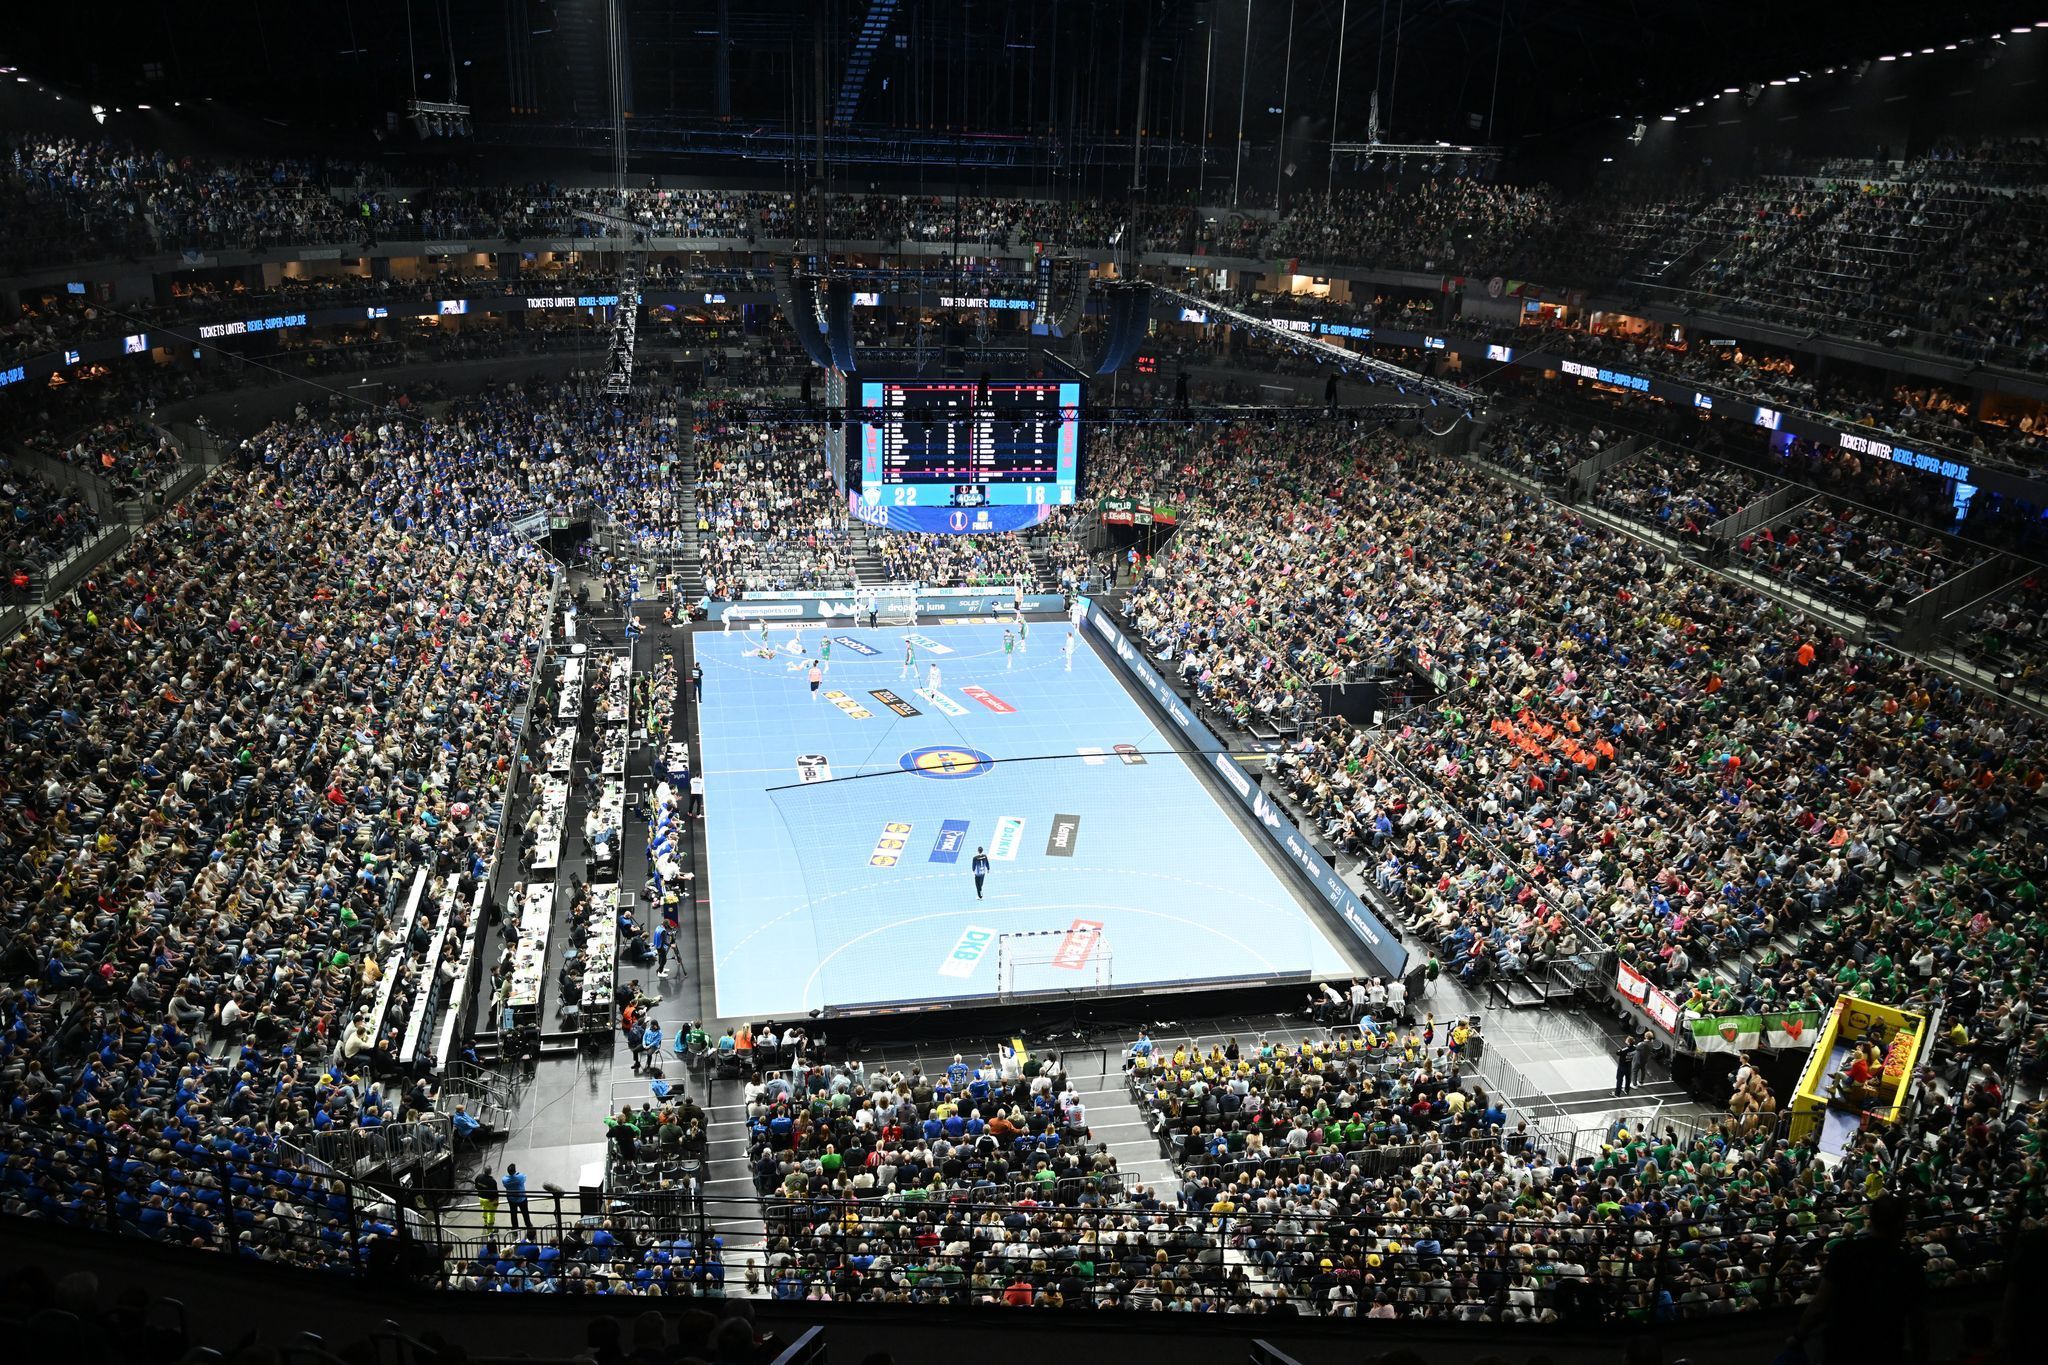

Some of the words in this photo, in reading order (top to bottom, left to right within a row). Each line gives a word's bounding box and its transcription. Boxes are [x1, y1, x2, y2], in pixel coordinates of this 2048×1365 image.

[527, 297, 554, 309] TICKETS
[199, 324, 225, 339] TICKETS
[225, 321, 247, 335] UNTER:
[247, 314, 306, 332] REXEL-SUPER-CUP.DE
[1561, 360, 1581, 375] TICKETS
[1581, 365, 1598, 379] UNTER:
[1840, 433, 1868, 453] TICKETS
[1867, 440, 1892, 460] UNTER:
[1892, 447, 1969, 482] REXEL-SUPER-CUP.DE
[894, 486, 917, 506] 22
[1026, 485, 1045, 505] 18
[858, 496, 889, 526] 2026
[926, 602, 945, 612] june
[879, 691, 898, 703] ZOLL
[896, 702, 916, 715] ZOLL
[804, 766, 816, 781] HBL
[942, 833, 958, 851] JYSK
[996, 827, 1014, 857] DAIKIN
[1052, 822, 1075, 848] Kempa
[1286, 834, 1303, 857] drops
[1301, 850, 1309, 865] in
[1306, 857, 1321, 878] june
[1327, 877, 1343, 896] SOLES
[1330, 892, 1339, 901] BY
[1352, 914, 1380, 945] MICHELIN
[953, 930, 991, 961] DKB
